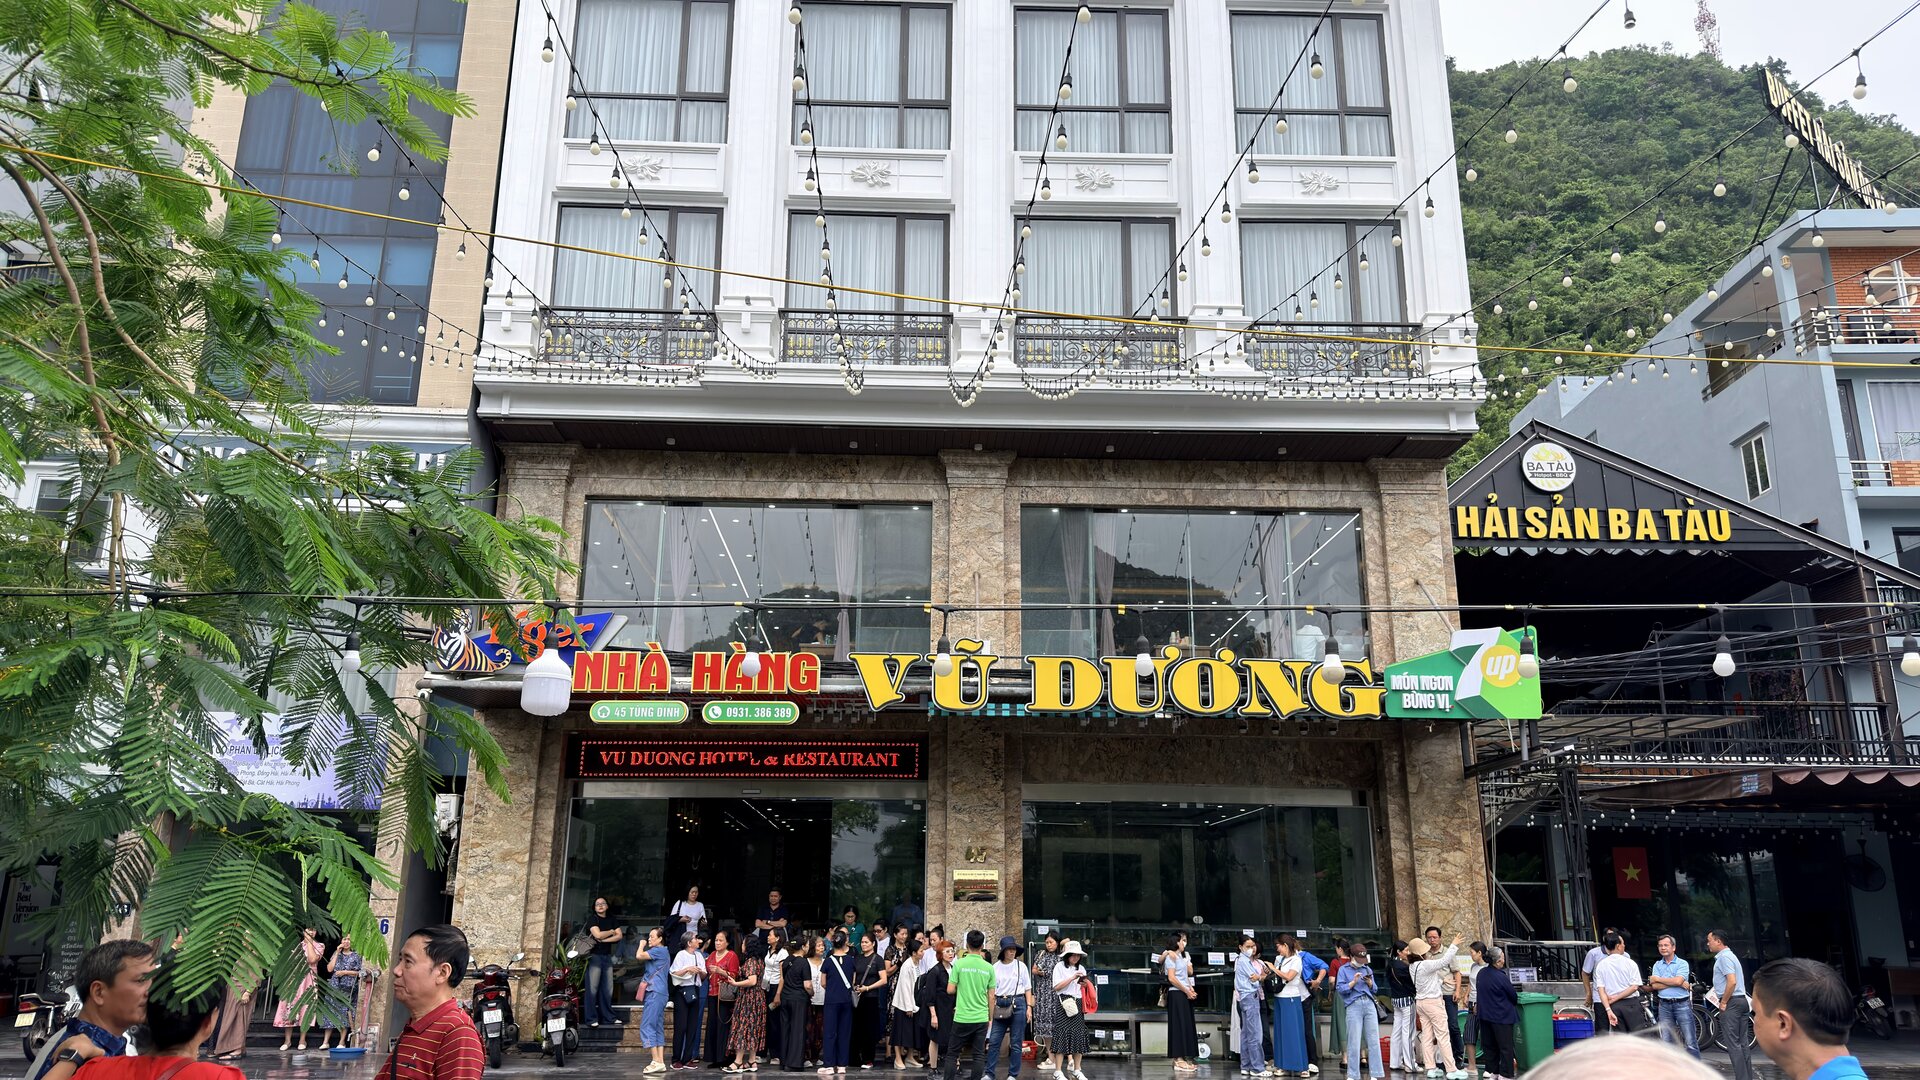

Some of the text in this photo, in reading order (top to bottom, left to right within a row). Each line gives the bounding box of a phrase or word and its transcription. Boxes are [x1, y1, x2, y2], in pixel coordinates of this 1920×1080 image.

[1526, 460, 1574, 472] BA TÀU
[1456, 492, 1732, 542] HẢI SẢN BA TÀU
[480, 609, 595, 664] ger
[572, 641, 821, 694] NHÀ HÀNG
[848, 637, 1388, 720] VŨ DƯƠNG
[1390, 672, 1454, 691] MÓN NGON
[614, 706, 627, 718] 45
[726, 707, 792, 718] 0931. 386 389
[600, 751, 625, 766] VU
[630, 751, 696, 766] DUONG
[783, 752, 900, 767] RESTAURANT
